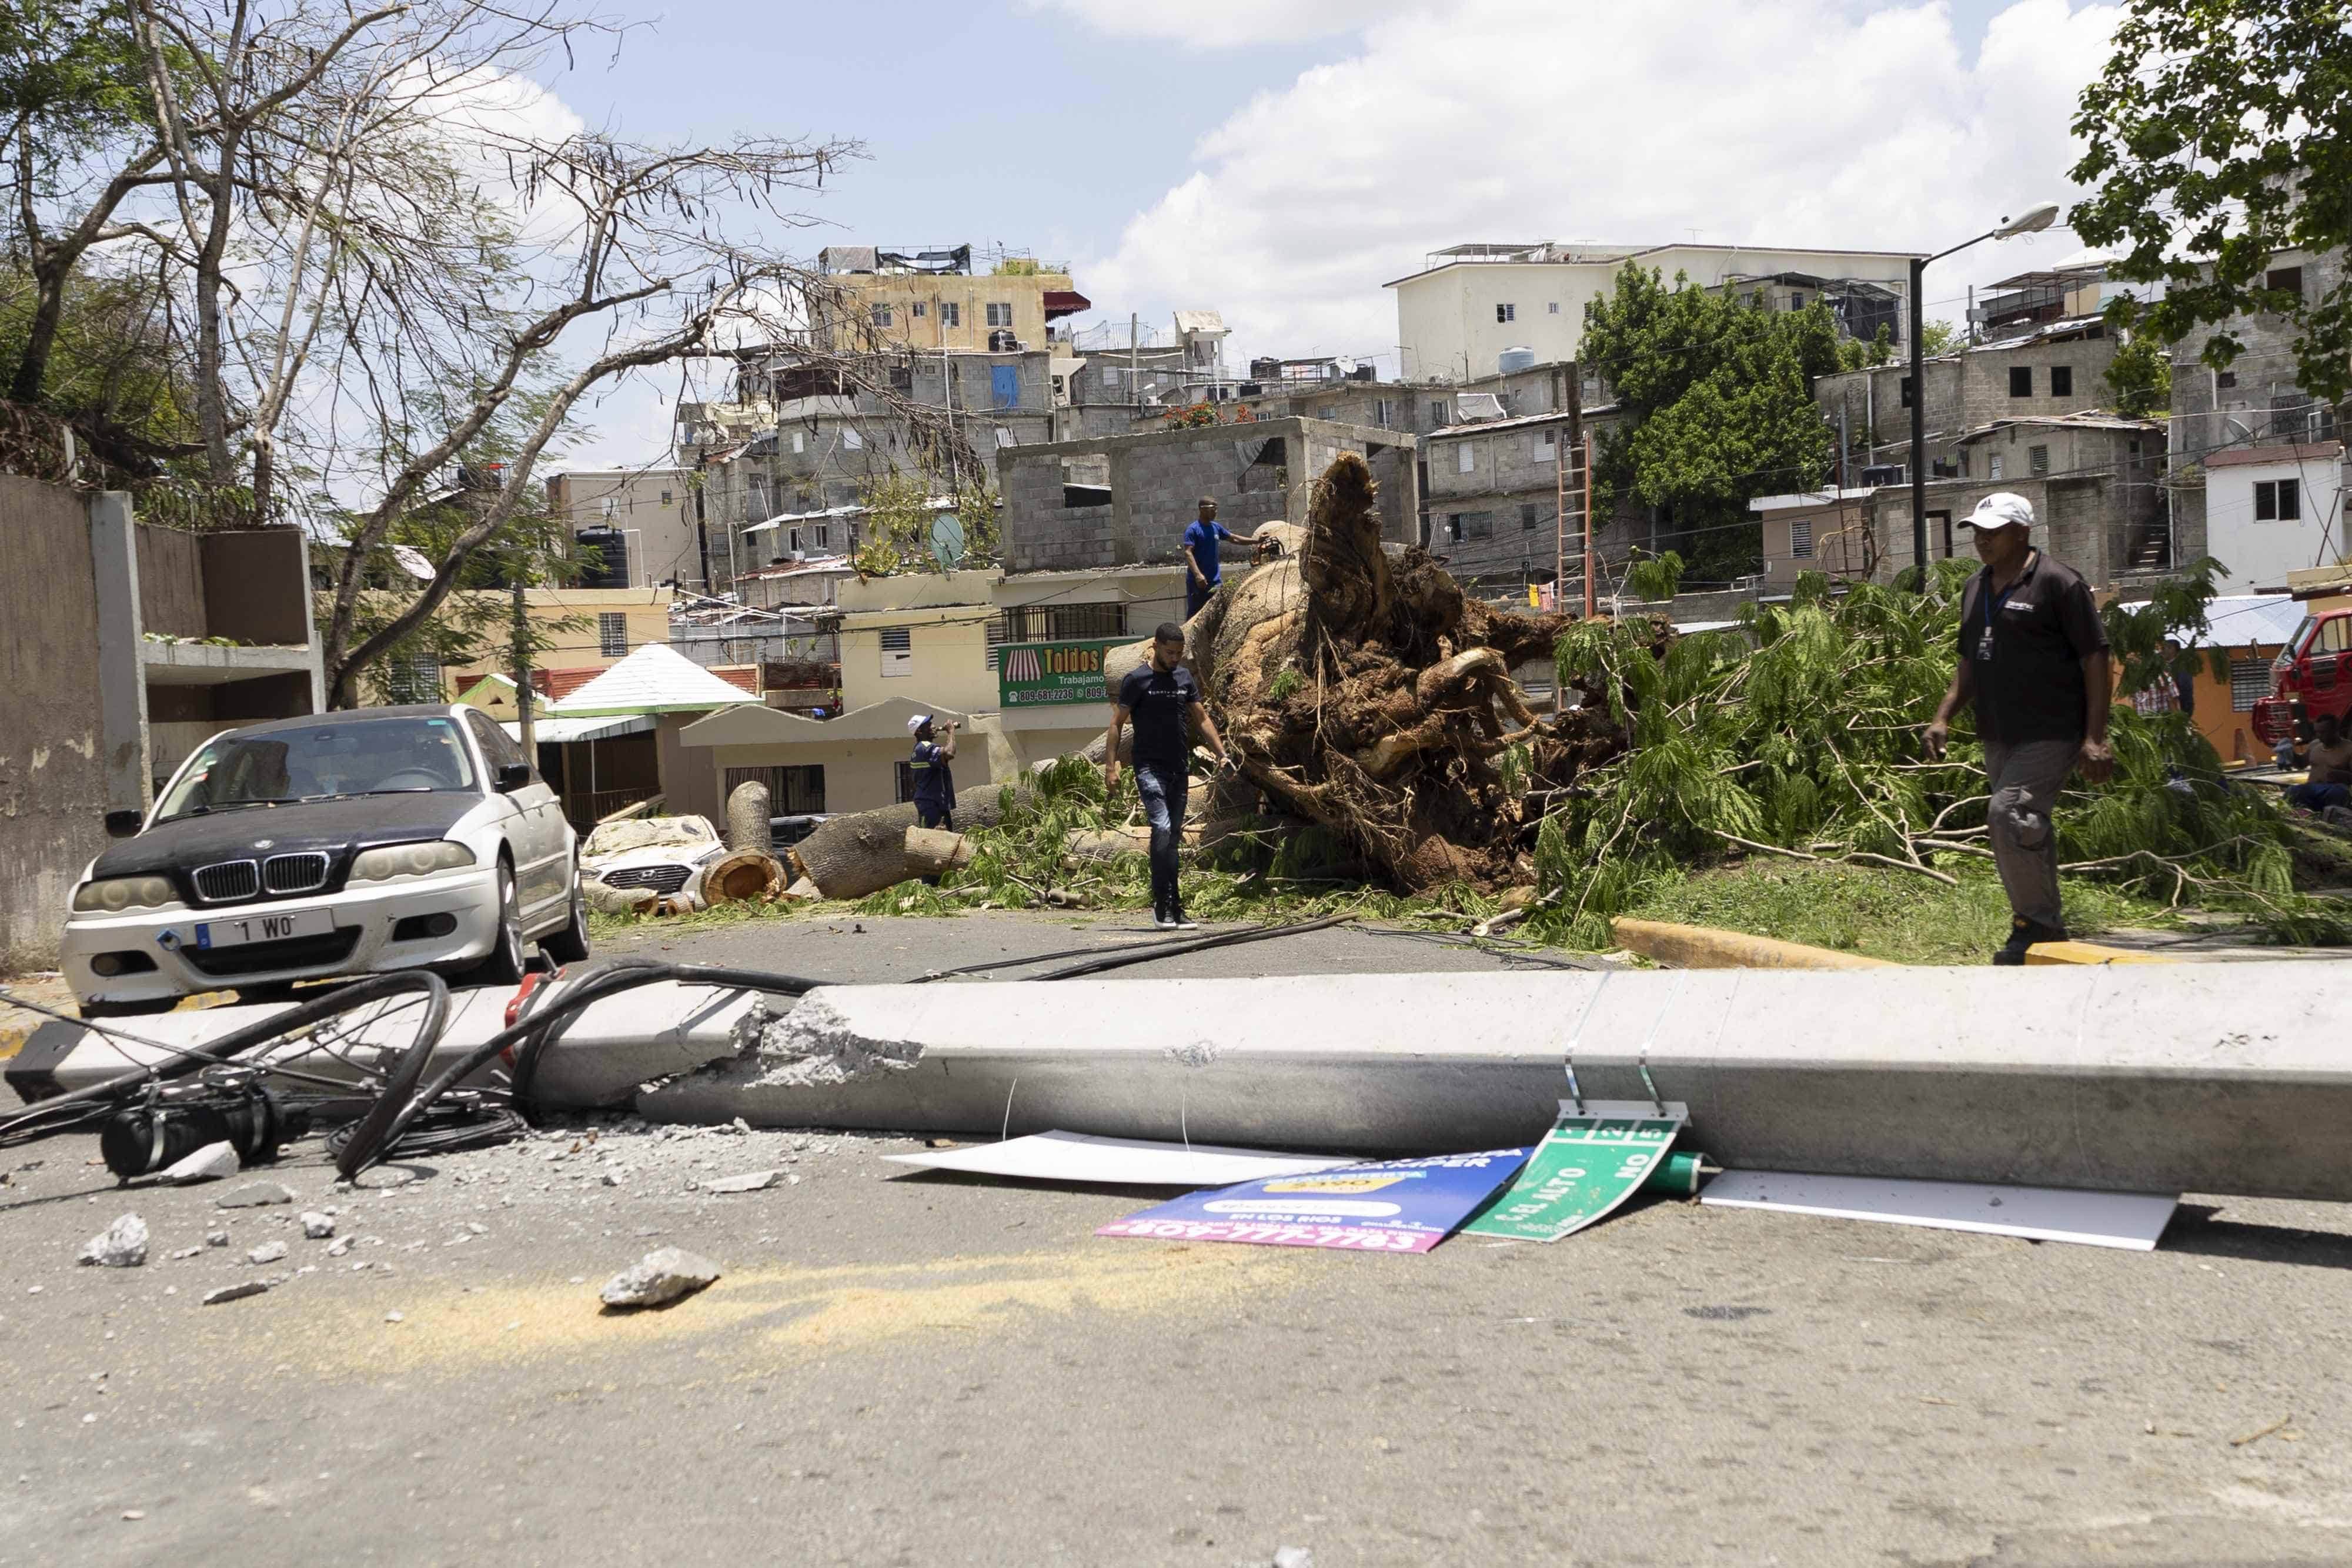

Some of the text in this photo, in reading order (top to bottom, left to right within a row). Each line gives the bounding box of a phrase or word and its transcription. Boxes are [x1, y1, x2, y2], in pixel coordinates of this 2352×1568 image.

[1043, 646, 1100, 674] Toldos
[1058, 675, 1104, 685] Trabajamo
[1019, 688, 1073, 702] 809-681-2236
[240, 921, 250, 941] 1
[1601, 1126, 1625, 1137] 2
[1639, 1128, 1663, 1139] 5
[1613, 1154, 1651, 1179] NO
[1532, 1168, 1587, 1202] ALTO
[1257, 1213, 1293, 1222] LOS
